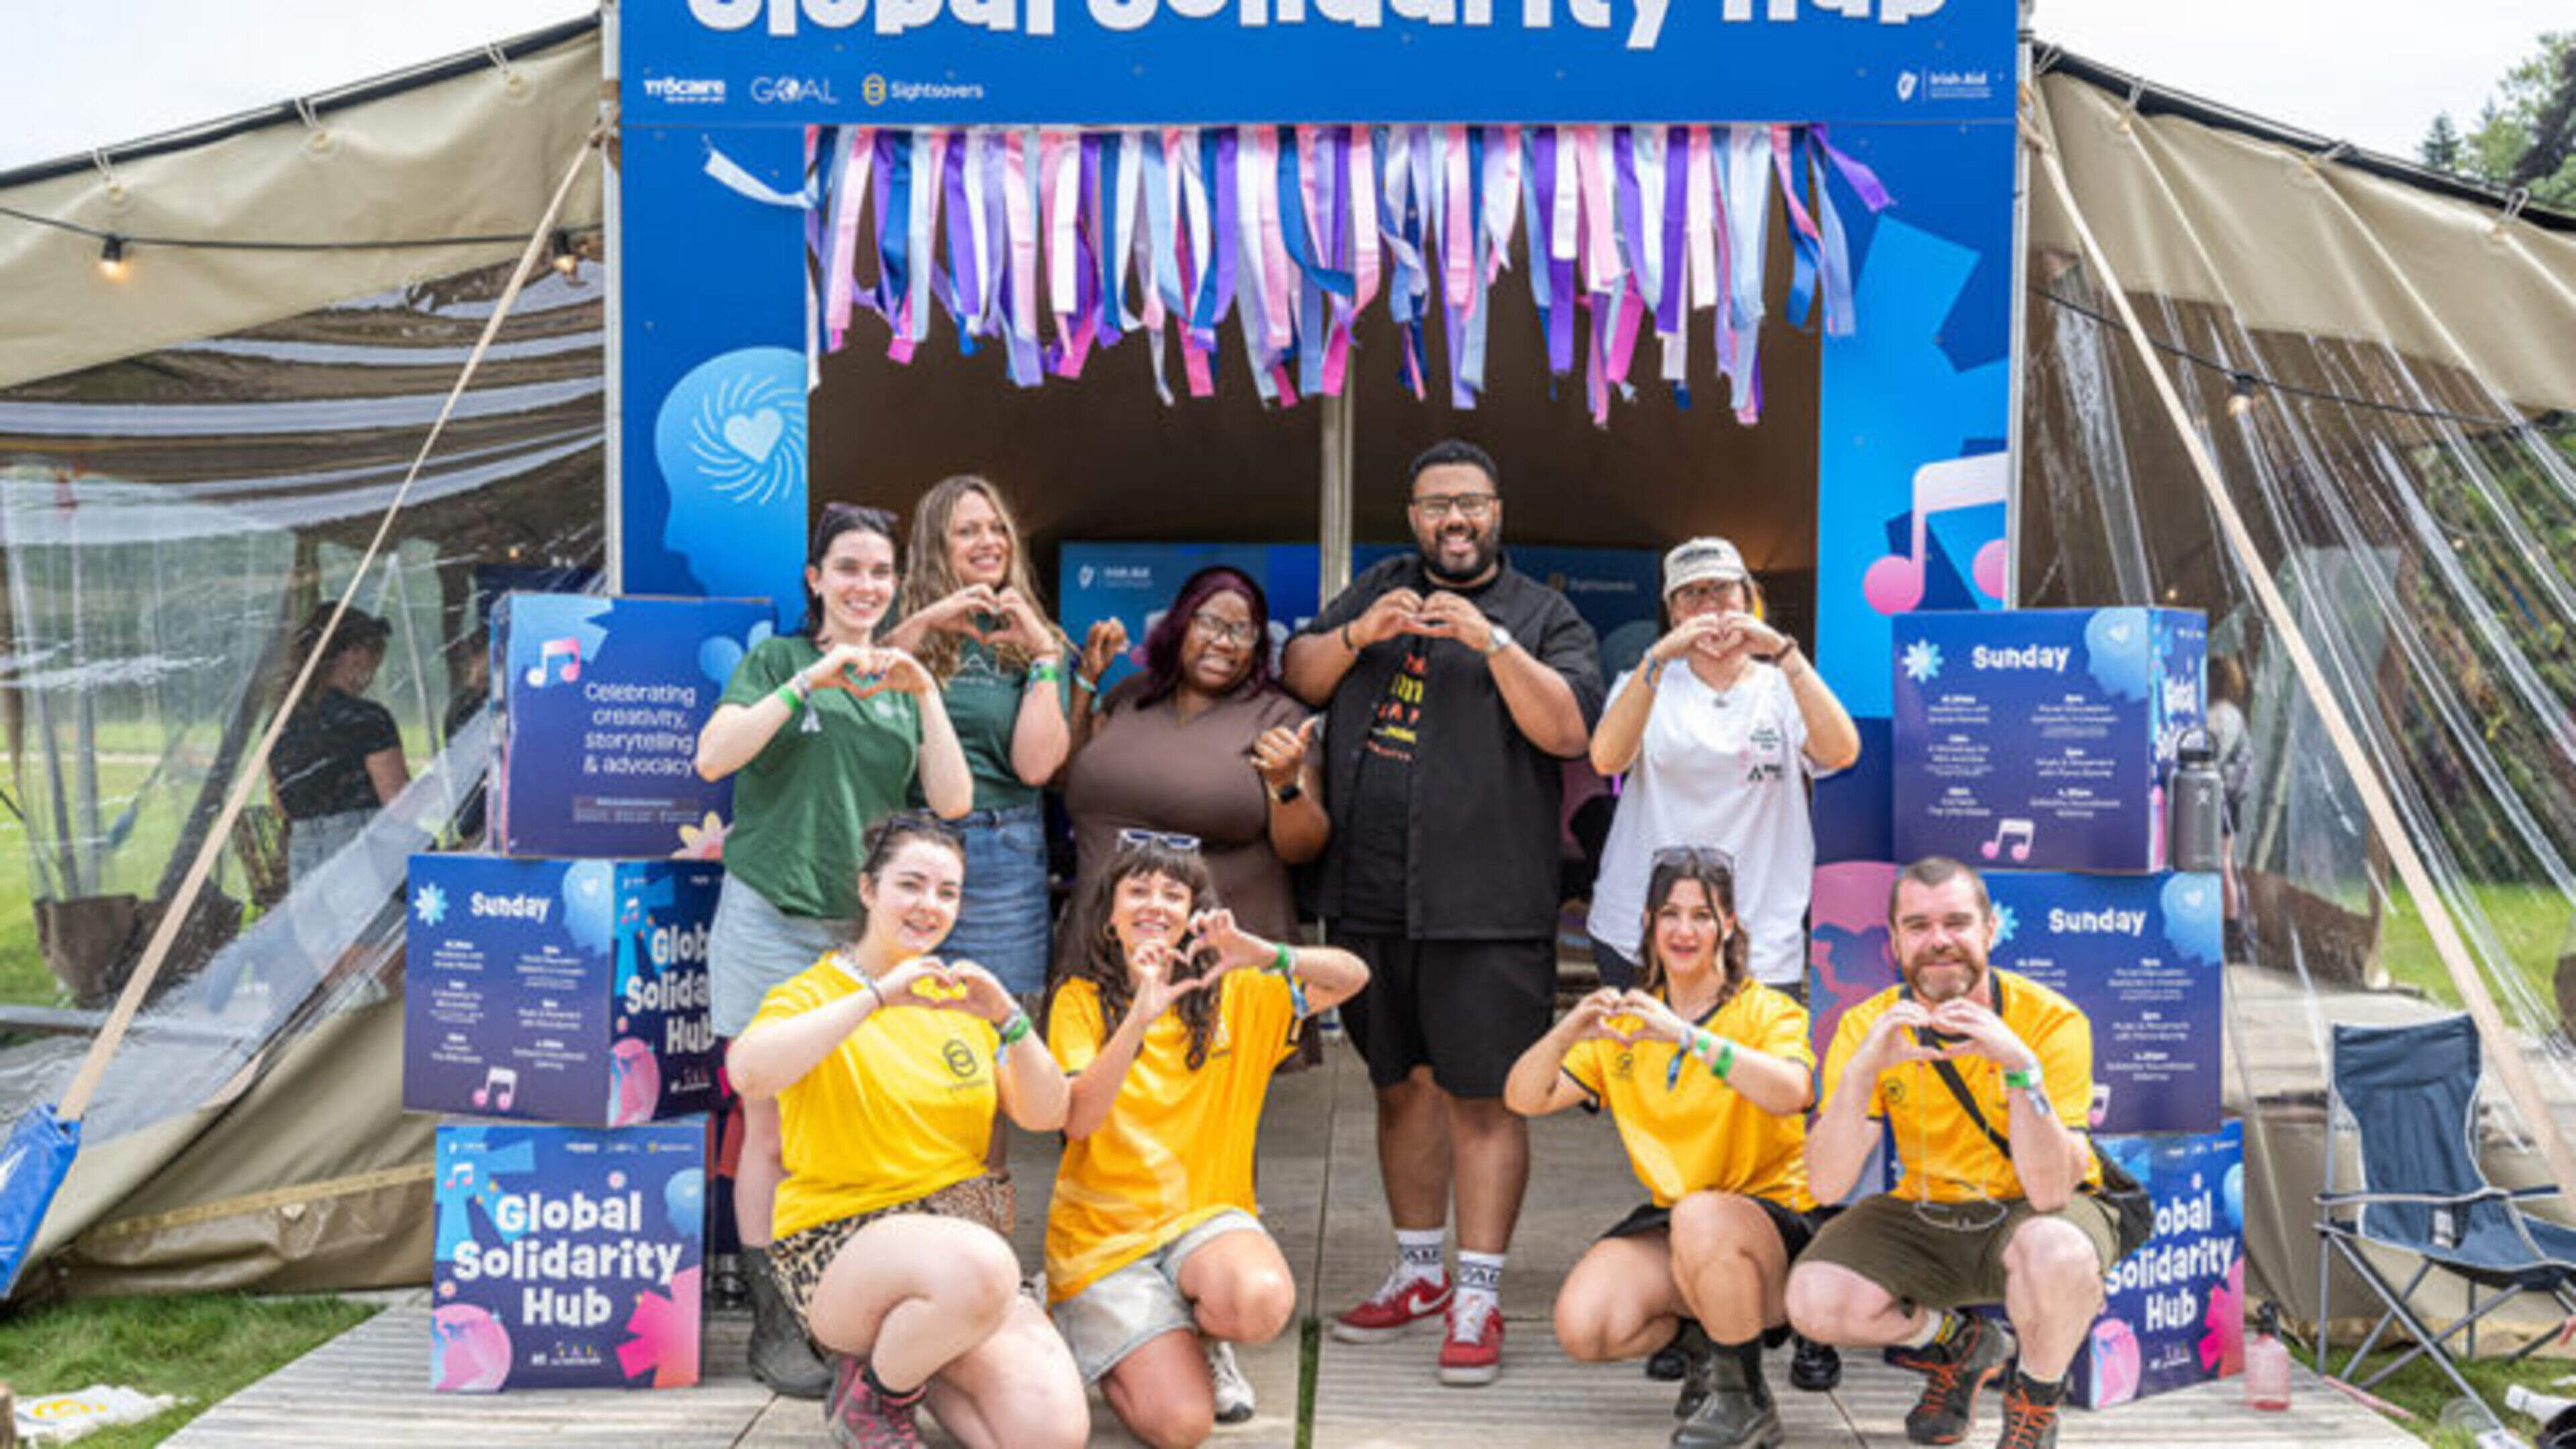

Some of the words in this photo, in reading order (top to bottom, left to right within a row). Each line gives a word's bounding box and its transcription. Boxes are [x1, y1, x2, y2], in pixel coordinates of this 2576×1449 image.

[1972, 645, 2070, 674] Sunday
[584, 683, 696, 708] Celebrating
[592, 706, 688, 729] creativity,
[583, 731, 695, 753] storytelling
[582, 755, 598, 773] &
[603, 755, 696, 777] advocacy
[470, 891, 551, 924] Sunday
[2048, 906, 2147, 937] Sunday
[651, 922, 709, 965] Glob
[625, 969, 709, 1014] Solida
[666, 1013, 716, 1055] Hub
[496, 1191, 642, 1233] Global
[2149, 1190, 2212, 1238] obal
[453, 1238, 683, 1286] Solidarity
[2104, 1236, 2235, 1295] Solidarity
[522, 1287, 612, 1327] Hub
[2146, 1287, 2198, 1332] Hub
